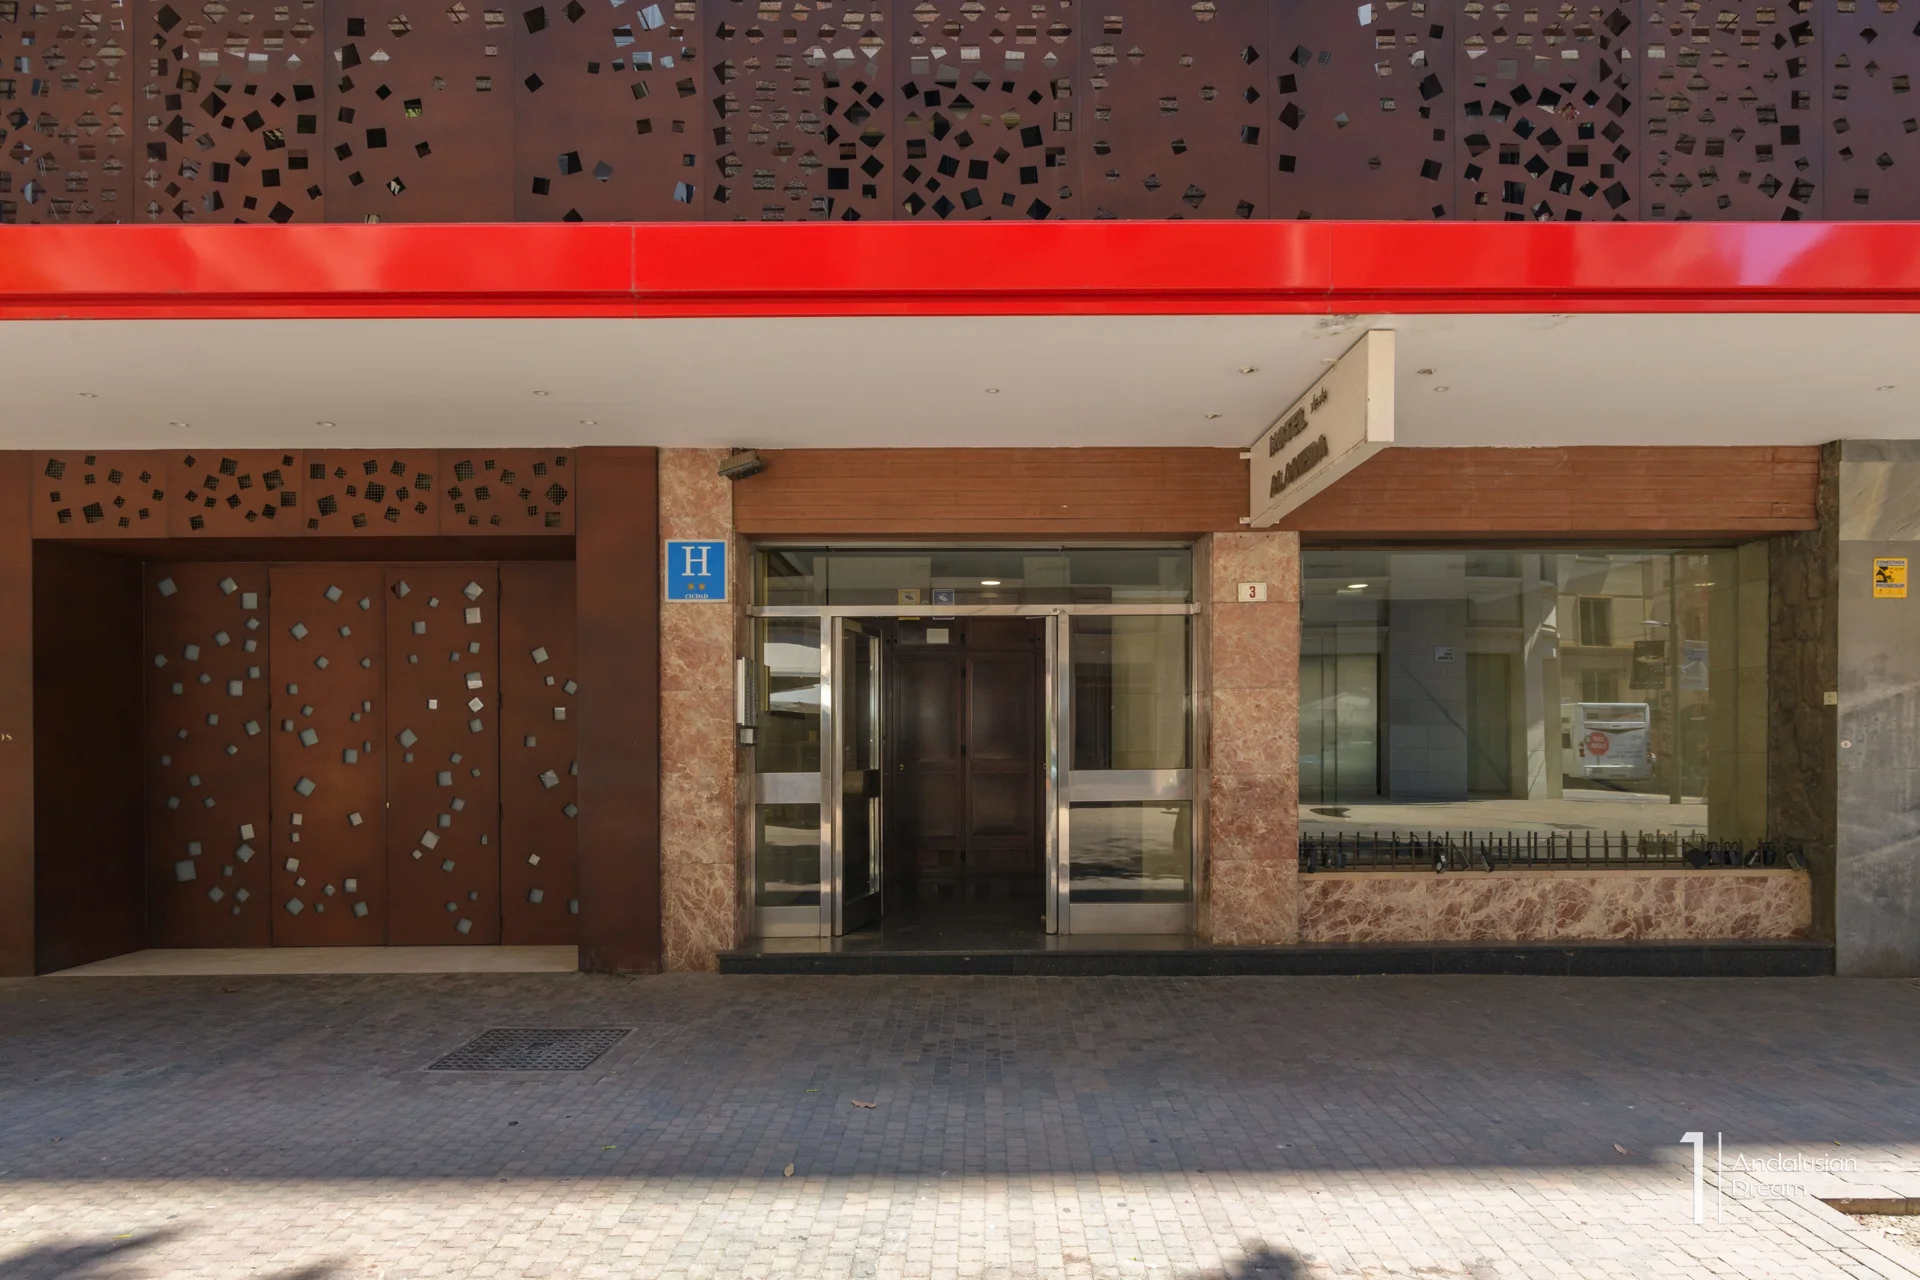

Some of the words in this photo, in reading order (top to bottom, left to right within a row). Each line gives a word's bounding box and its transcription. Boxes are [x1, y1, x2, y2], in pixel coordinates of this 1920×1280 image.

[1269, 406, 1308, 458] HOTEL
[681, 546, 711, 576] H
[1249, 586, 1256, 598] 3
